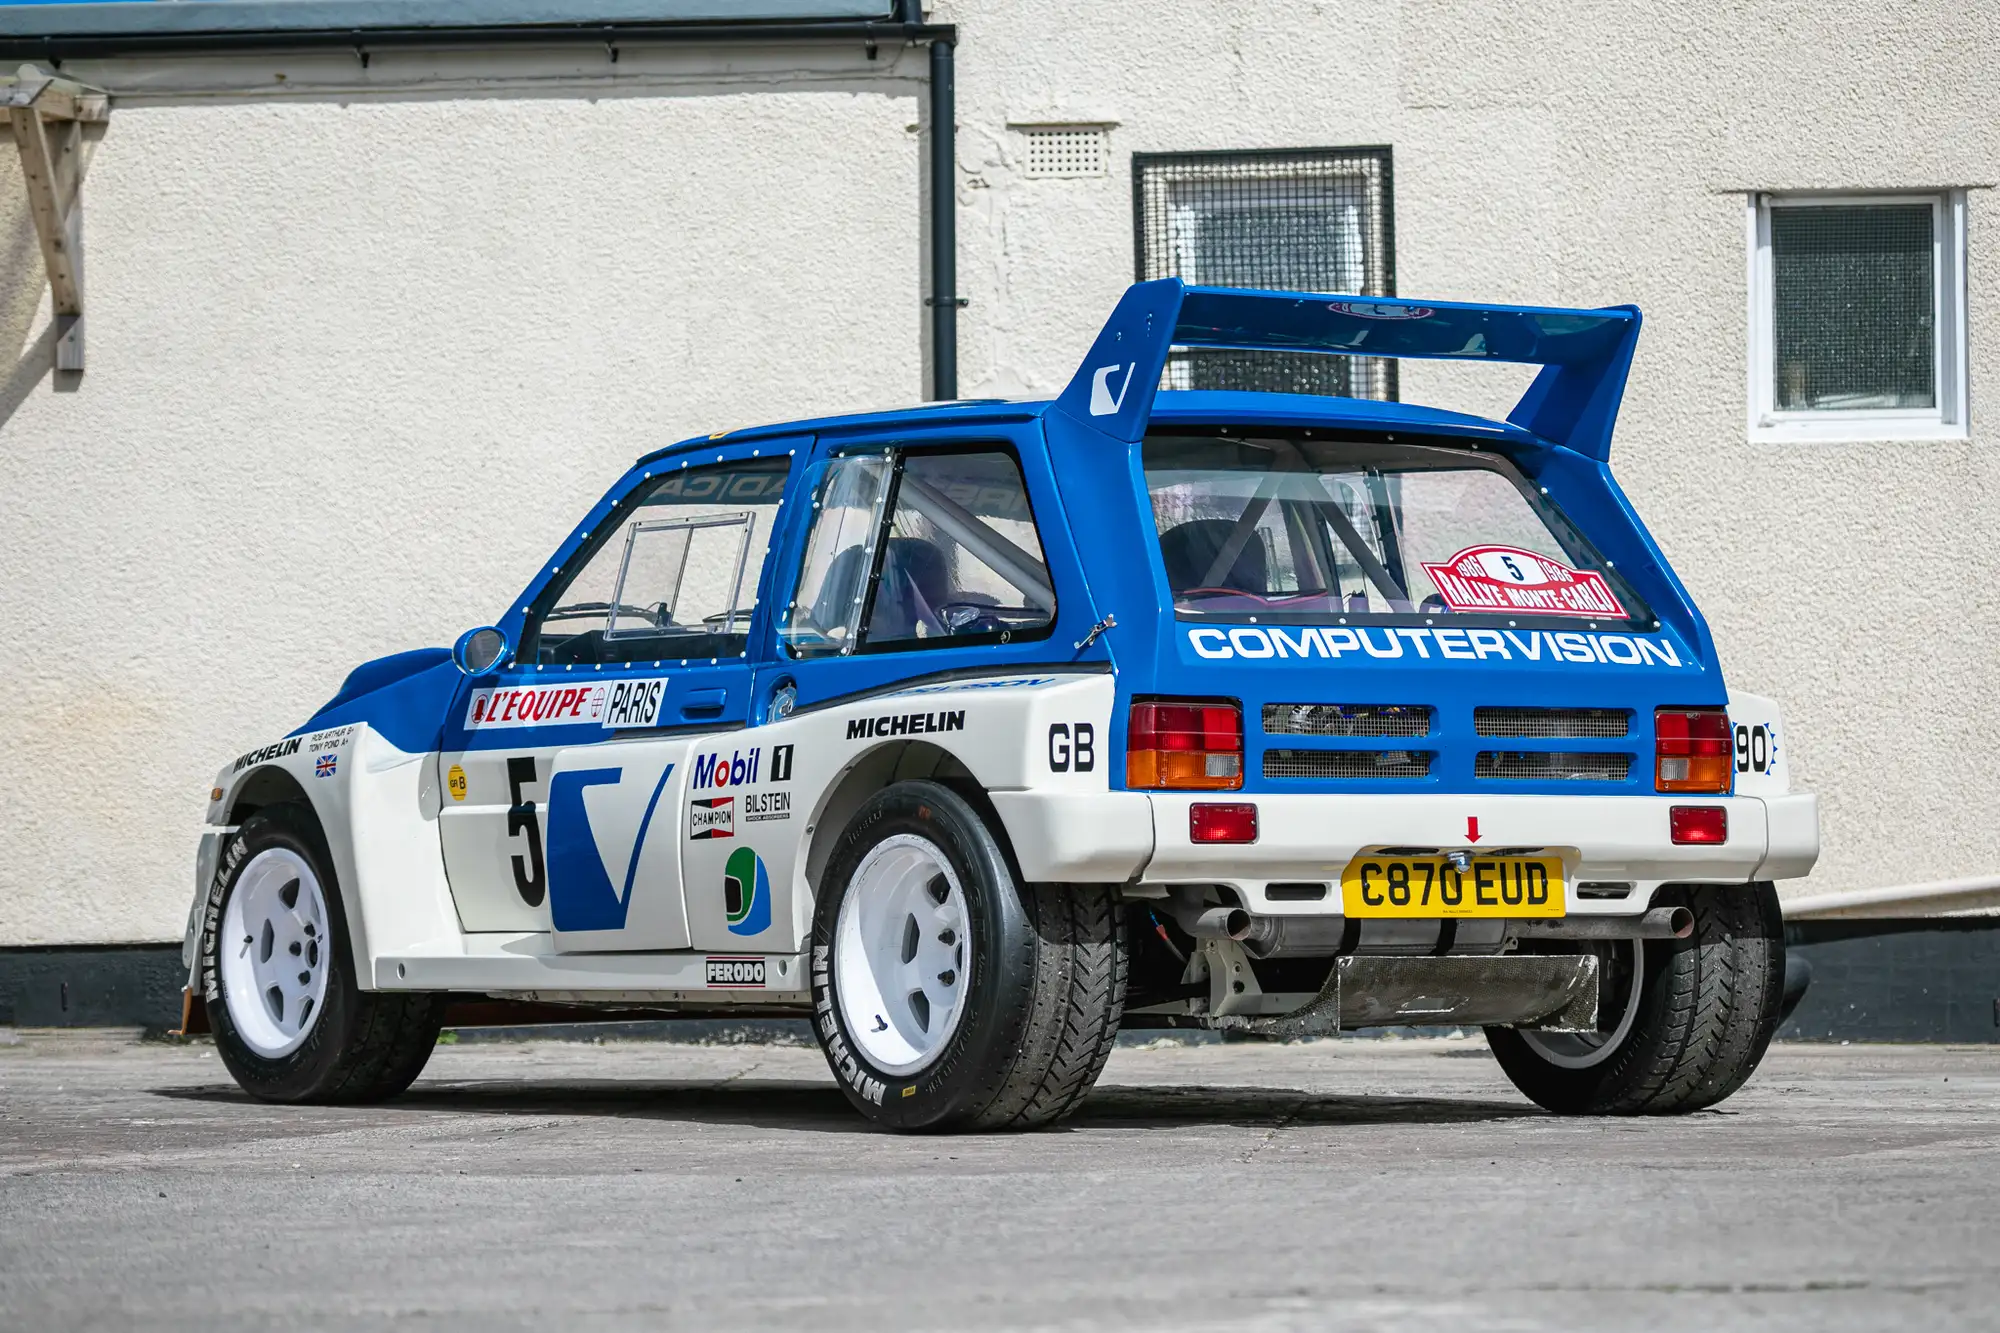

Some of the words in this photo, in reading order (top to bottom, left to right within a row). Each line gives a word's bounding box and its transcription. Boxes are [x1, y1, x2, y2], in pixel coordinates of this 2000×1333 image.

[1456, 555, 1486, 578] 1986
[1500, 556, 1525, 581] 5
[1538, 560, 1574, 582] 1986
[1433, 569, 1509, 607] RALLYE
[1504, 577, 1616, 612] MONTE-CARLO
[1188, 628, 1682, 667] COMPUTERVISION
[607, 680, 661, 723] PARIS
[312, 733, 323, 741] ROB
[323, 728, 346, 739] ARTHUR
[846, 710, 966, 740] MICHELIN
[233, 737, 303, 774] MICHELIN
[309, 742, 324, 752] TONY
[324, 739, 339, 750] POND
[1049, 722, 1095, 772] GB
[1736, 725, 1766, 772] 90
[459, 776, 466, 789] B
[692, 747, 761, 790] Mobil
[692, 810, 732, 827] CHAMPION
[745, 792, 791, 814] BILSTEIN
[507, 756, 546, 908] 5
[1361, 862, 1463, 906] C870
[1473, 862, 1548, 906] EUD
[203, 836, 249, 1004] MICHELIN
[706, 962, 765, 982] FERODO
[812, 945, 887, 1107] MICHELIN
